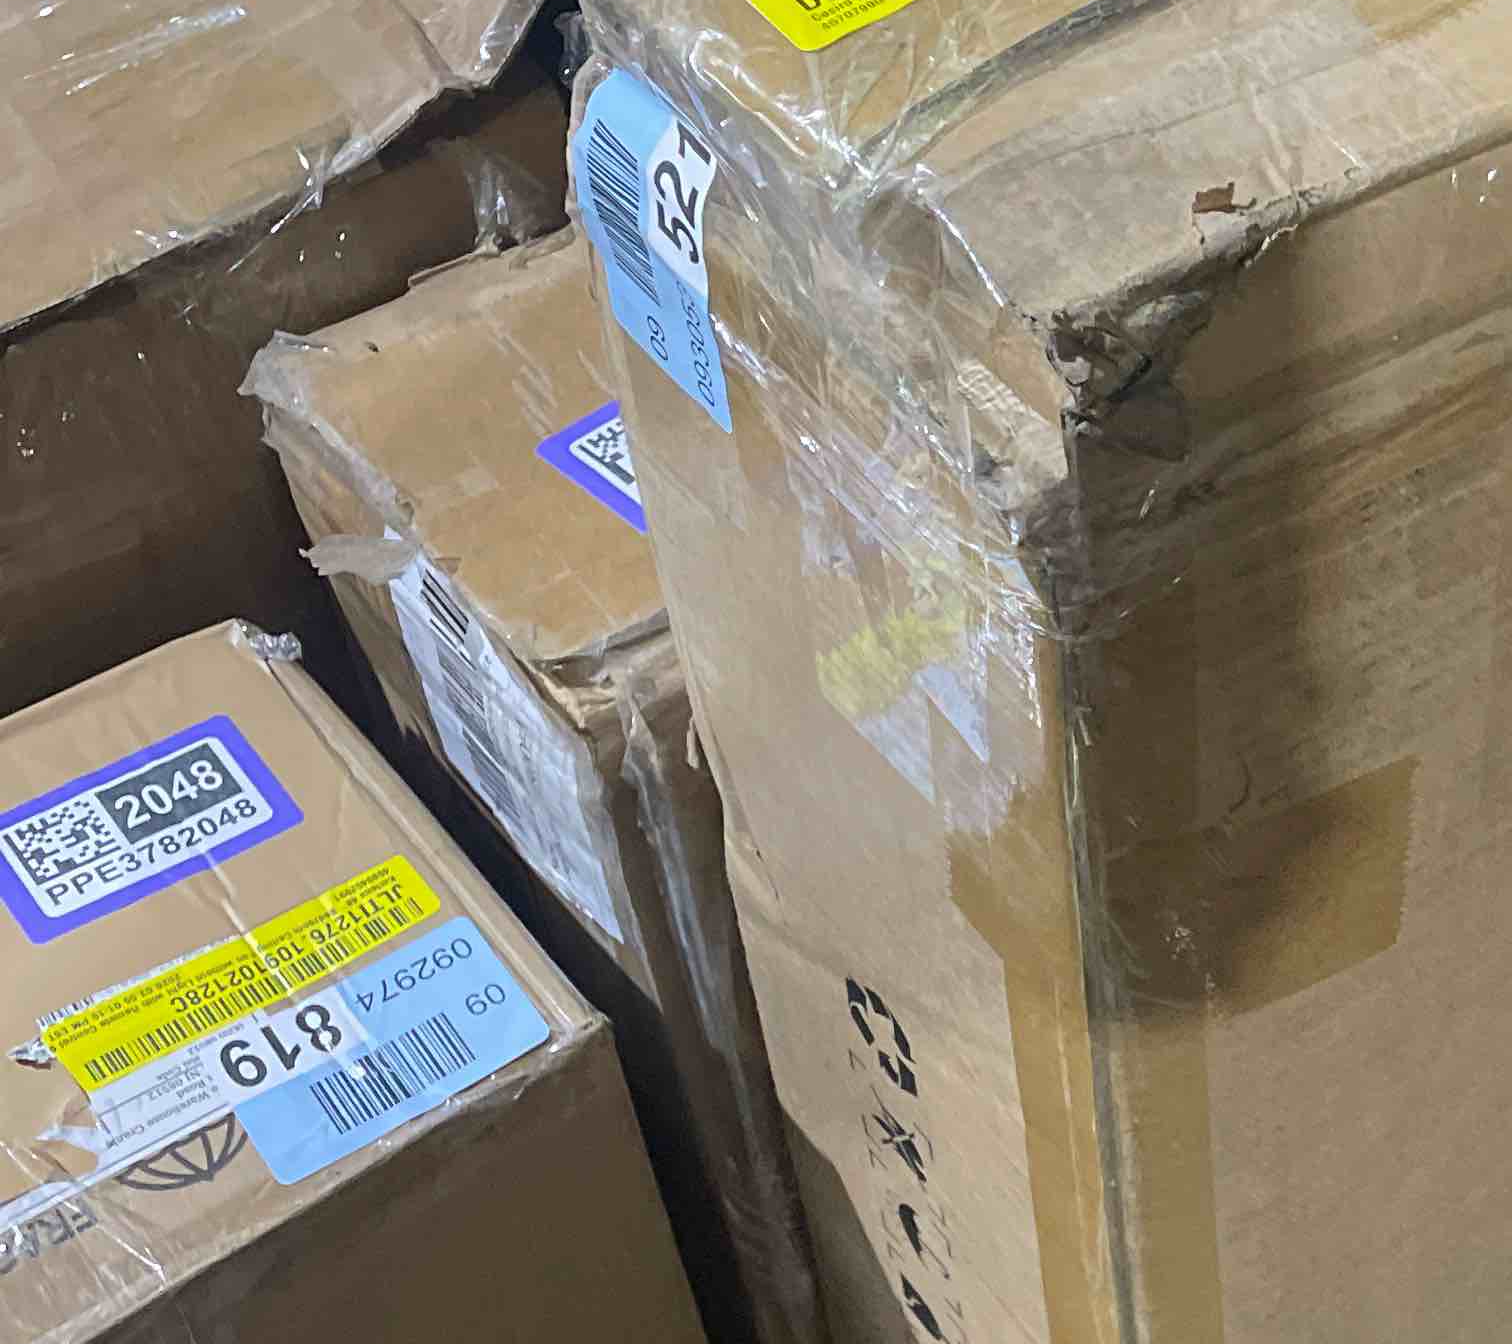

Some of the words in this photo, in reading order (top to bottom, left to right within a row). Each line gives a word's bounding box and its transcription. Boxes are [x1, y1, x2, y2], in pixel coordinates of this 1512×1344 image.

[653, 118, 713, 265] 521
[646, 314, 670, 363] 09
[113, 759, 226, 830] 2048
[46, 798, 258, 905] PPE3782048
[354, 937, 474, 1014] 092974
[465, 982, 507, 1017] 09
[218, 1003, 343, 1090] 819
